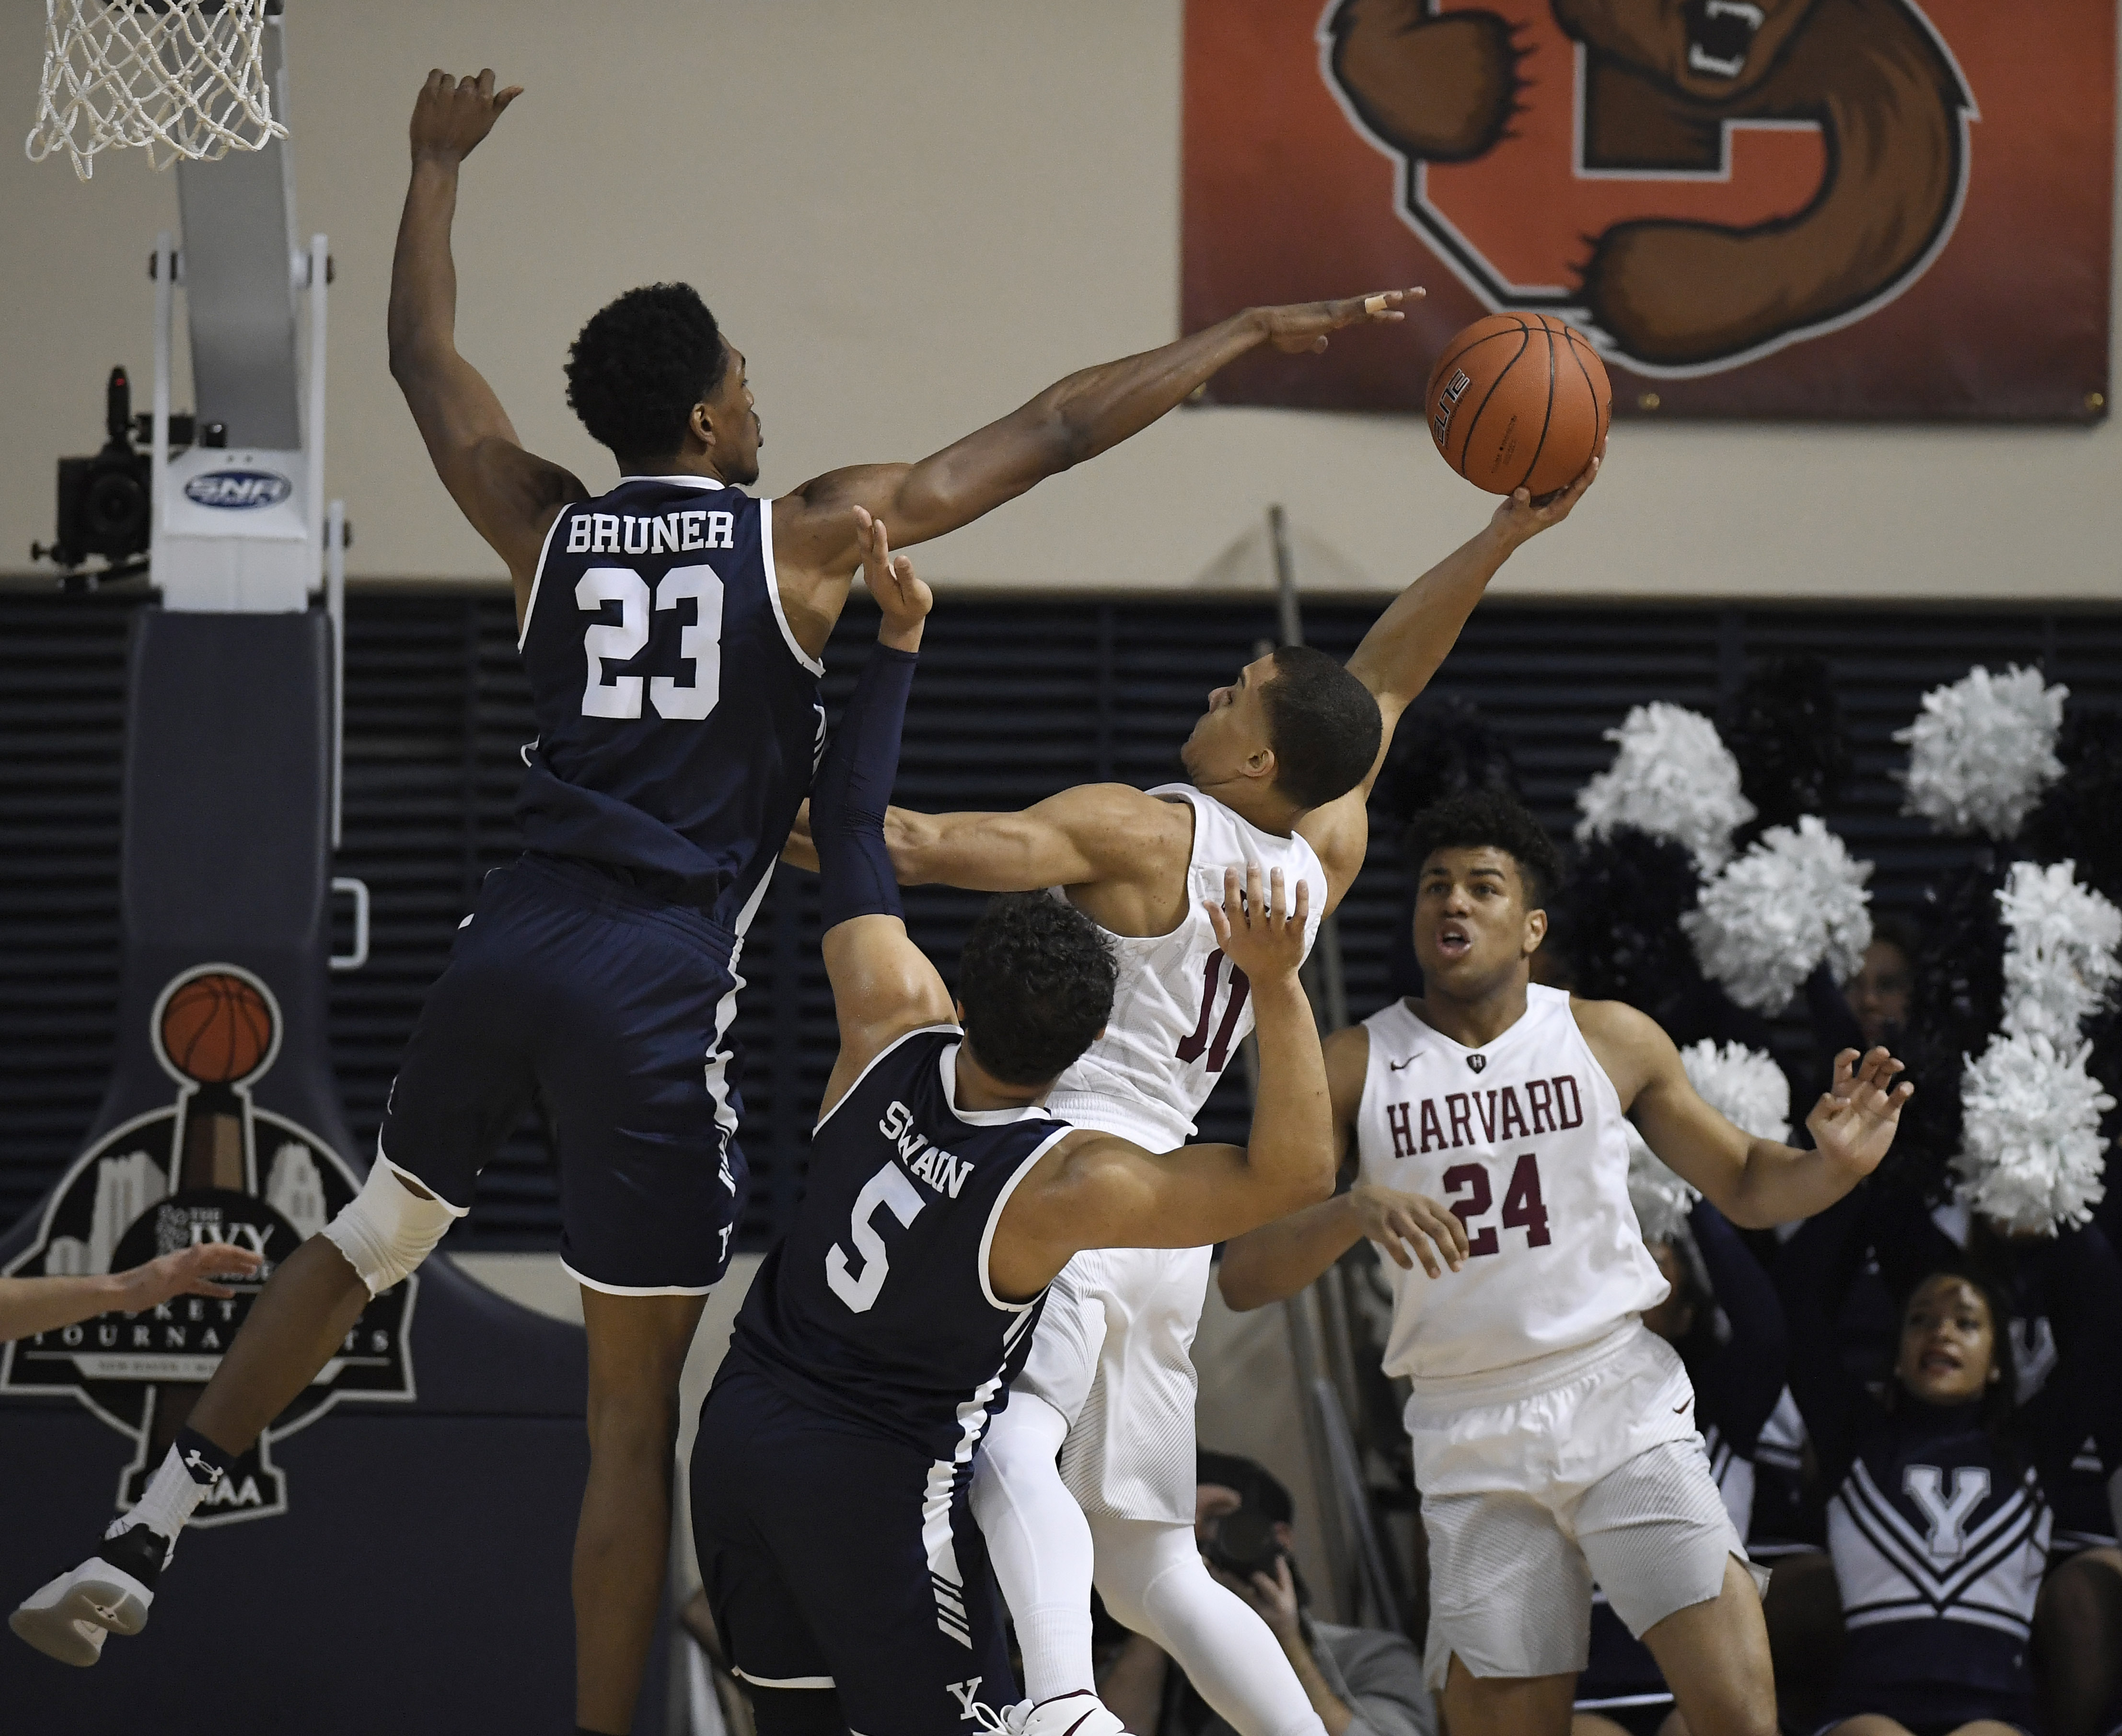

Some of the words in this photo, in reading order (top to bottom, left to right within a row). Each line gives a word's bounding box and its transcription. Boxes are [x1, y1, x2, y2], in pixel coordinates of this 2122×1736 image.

[1434, 368, 1470, 446] ELITE
[567, 511, 734, 554] BRUNER
[575, 565, 724, 720] 23
[879, 1101, 975, 1199] SWAIN
[1387, 1075, 1583, 1158] HARVARD
[825, 1160, 927, 1313] 5
[1443, 1153, 1551, 1257] 24
[1902, 1465, 1991, 1559] Y
[946, 1677, 983, 1720] Y
